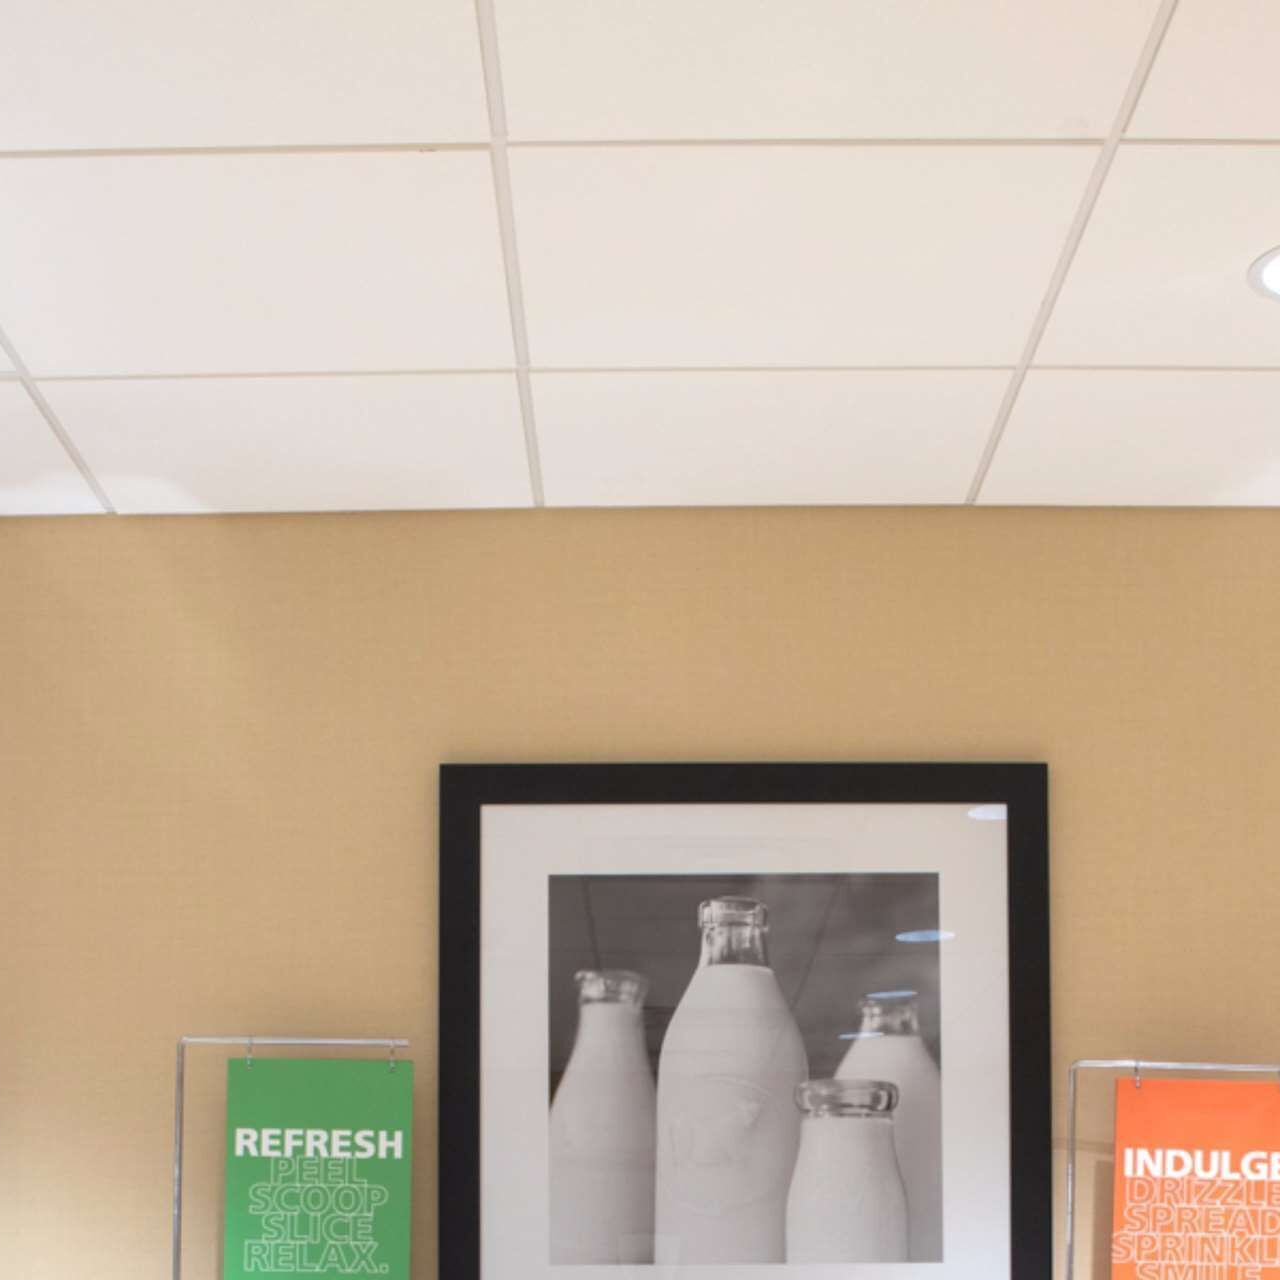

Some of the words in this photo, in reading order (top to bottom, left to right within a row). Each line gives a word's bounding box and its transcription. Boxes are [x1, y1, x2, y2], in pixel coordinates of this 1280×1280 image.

[234, 1127, 404, 1160] REFRESH
[271, 1155, 368, 1186] PEEL
[248, 1182, 389, 1217] SCOOP
[261, 1212, 374, 1244] SLICE
[243, 1239, 390, 1274] RELAX.
